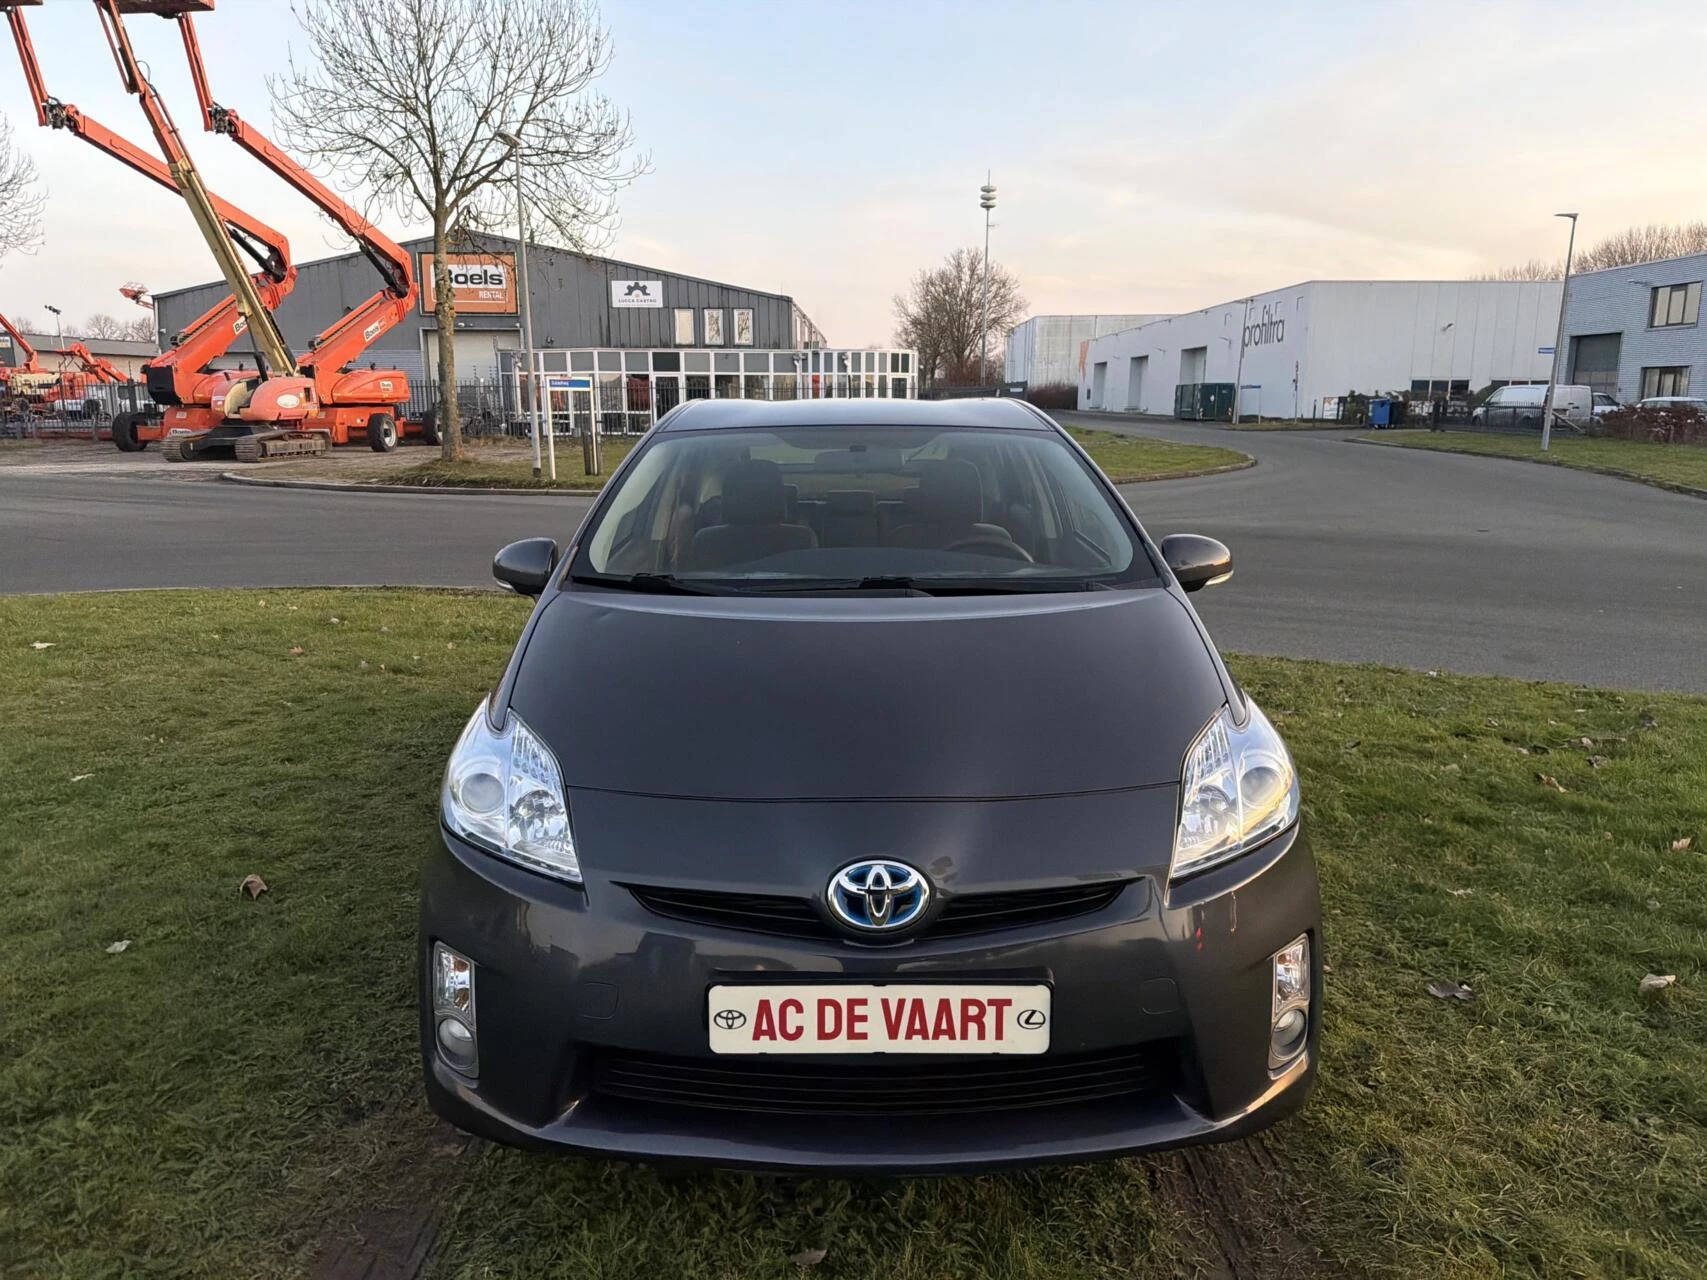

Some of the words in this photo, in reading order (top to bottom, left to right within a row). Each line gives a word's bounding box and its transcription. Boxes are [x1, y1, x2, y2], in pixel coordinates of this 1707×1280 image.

[752, 998, 804, 1041] AC
[816, 998, 868, 1040] DE
[880, 998, 1013, 1041] VAART
